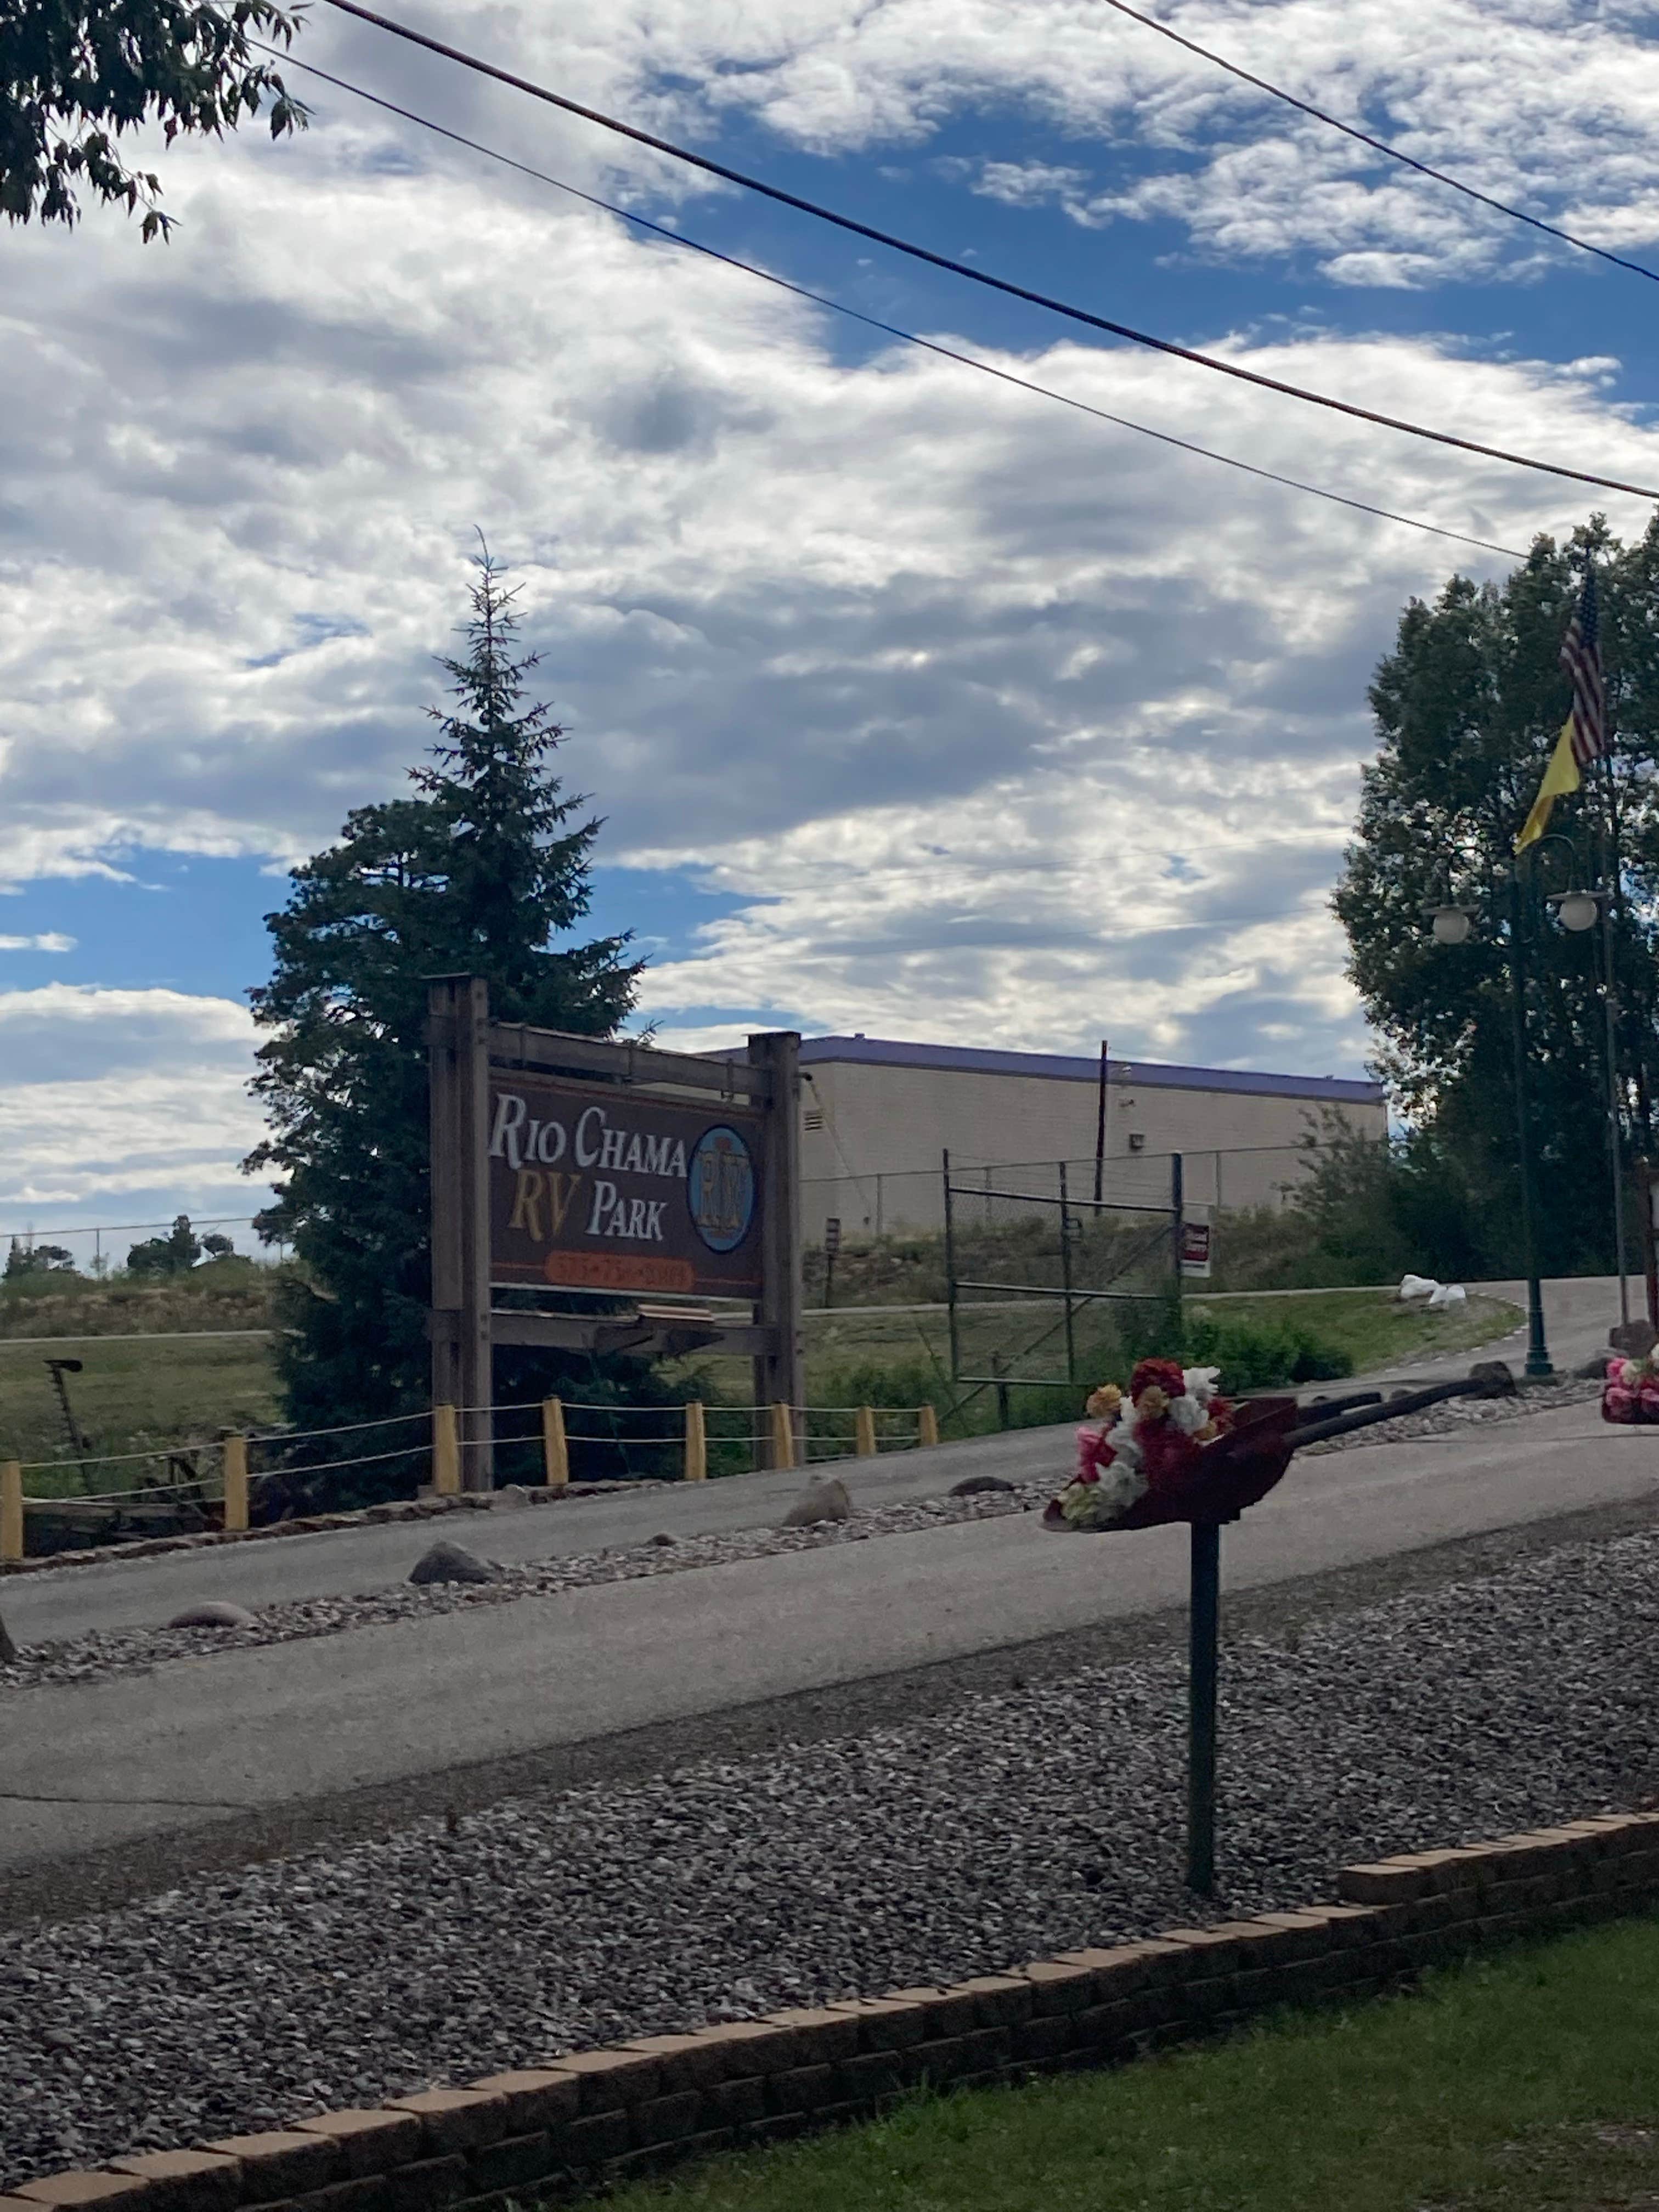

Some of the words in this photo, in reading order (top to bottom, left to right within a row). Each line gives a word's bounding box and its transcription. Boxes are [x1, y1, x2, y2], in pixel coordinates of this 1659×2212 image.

[488, 1093, 566, 1170] RIO
[575, 1106, 688, 1178] CHAMA
[507, 1169, 582, 1242] RV
[584, 1180, 668, 1242] PARK
